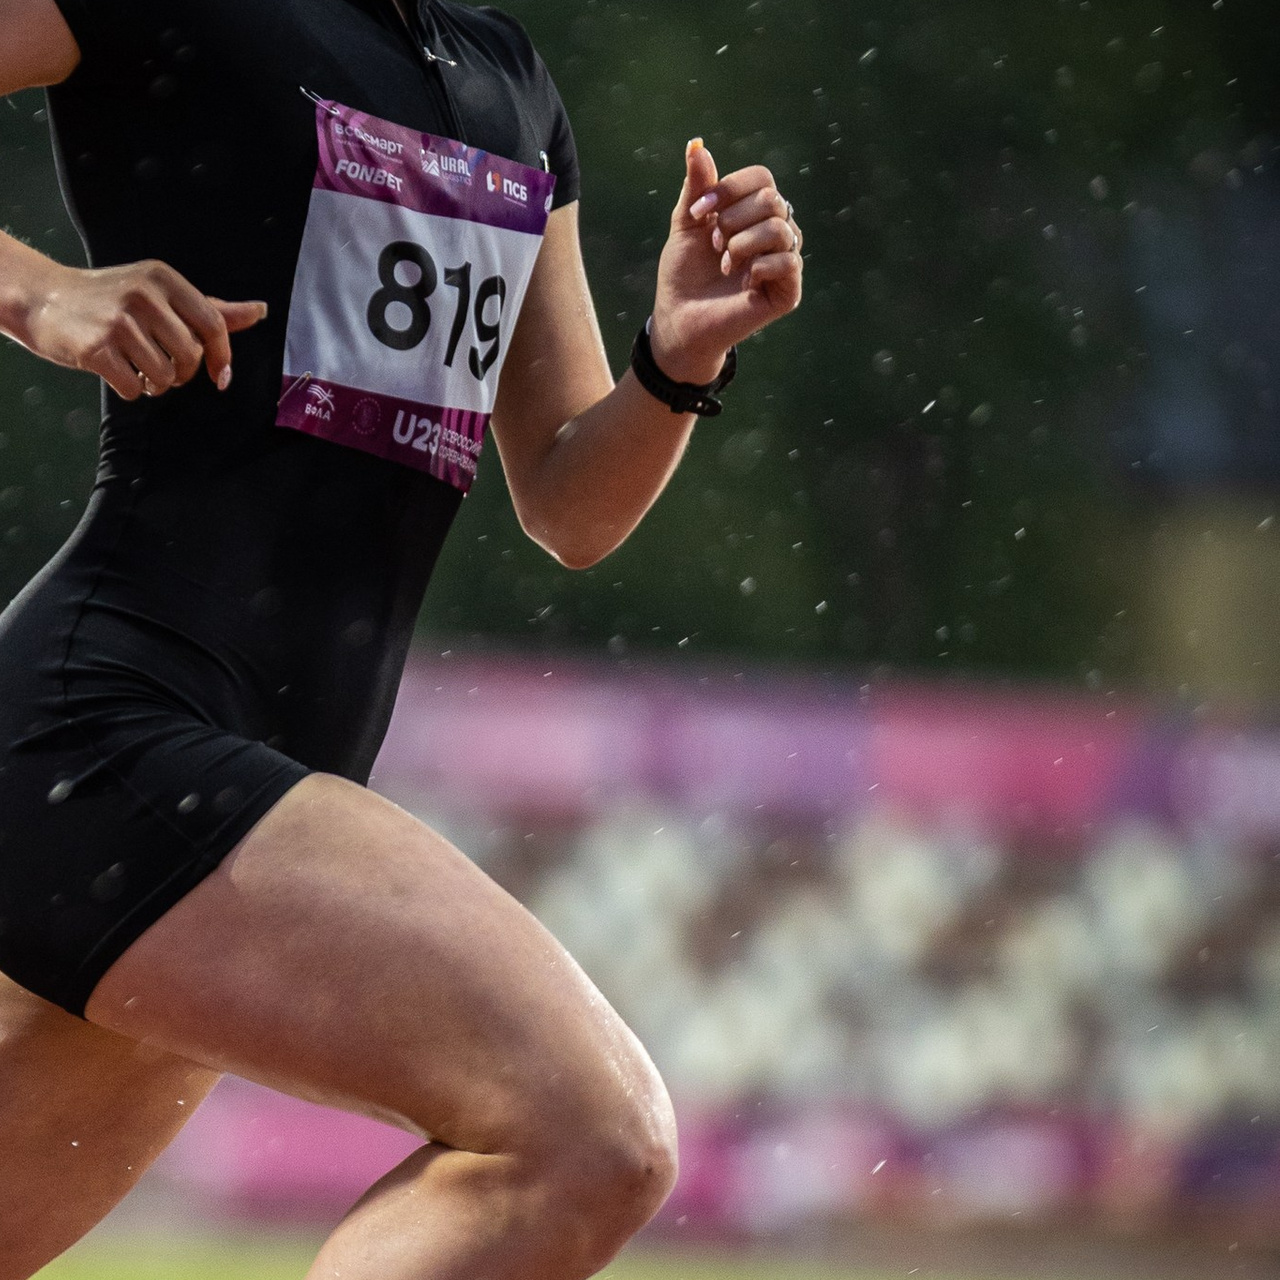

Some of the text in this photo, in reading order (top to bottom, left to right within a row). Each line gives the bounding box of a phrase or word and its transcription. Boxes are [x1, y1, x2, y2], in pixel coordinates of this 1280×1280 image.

[334, 159, 403, 192] FONBET
[440, 154, 472, 177] URAL
[503, 177, 528, 201] ПСБ
[367, 240, 506, 381] 819
[392, 409, 441, 456] U23
